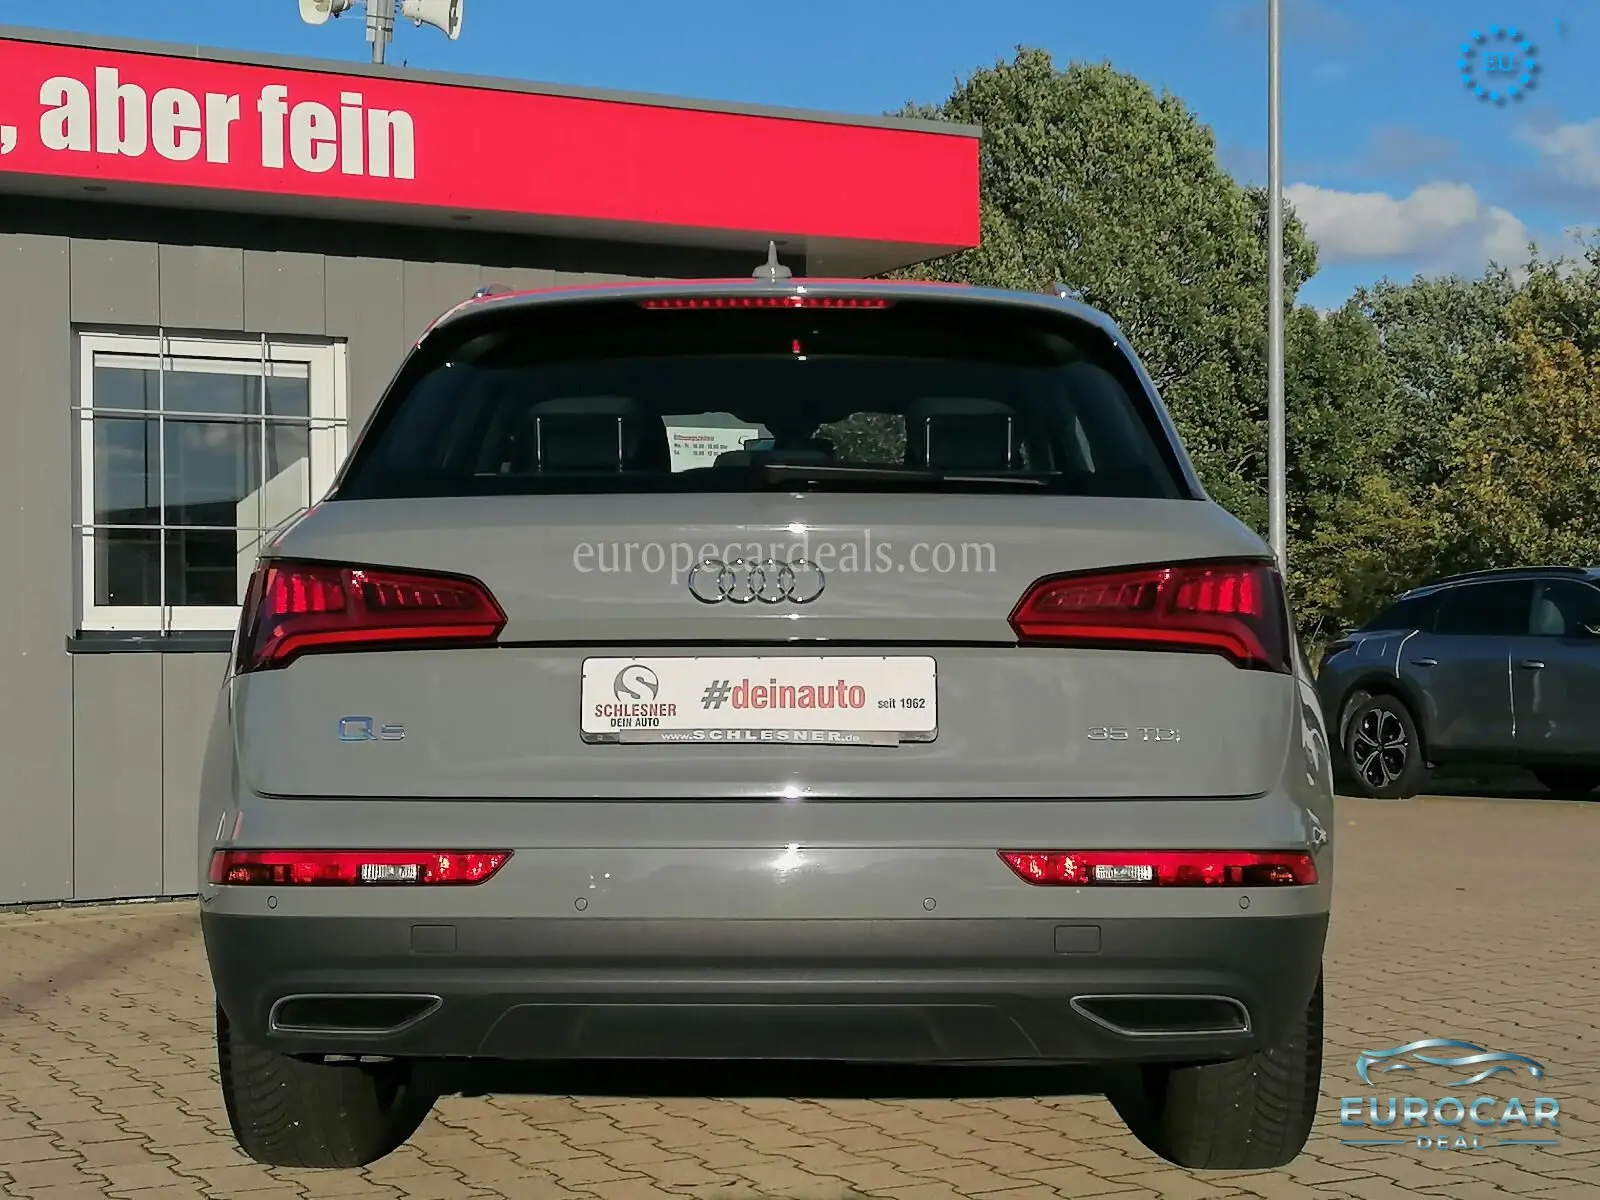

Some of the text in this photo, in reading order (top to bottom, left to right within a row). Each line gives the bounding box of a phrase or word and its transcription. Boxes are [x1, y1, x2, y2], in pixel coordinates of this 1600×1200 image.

[39, 66, 240, 164] aber
[257, 84, 416, 180] fein
[701, 679, 866, 710] #deinauto
[594, 703, 677, 717] SCHLESNER
[877, 698, 926, 709] seit 1962
[338, 715, 406, 741] Q5
[610, 717, 660, 728] DEIN AUTO
[660, 729, 860, 743] www.SCHLESNER.de
[1087, 726, 1181, 742] 35 TDI
